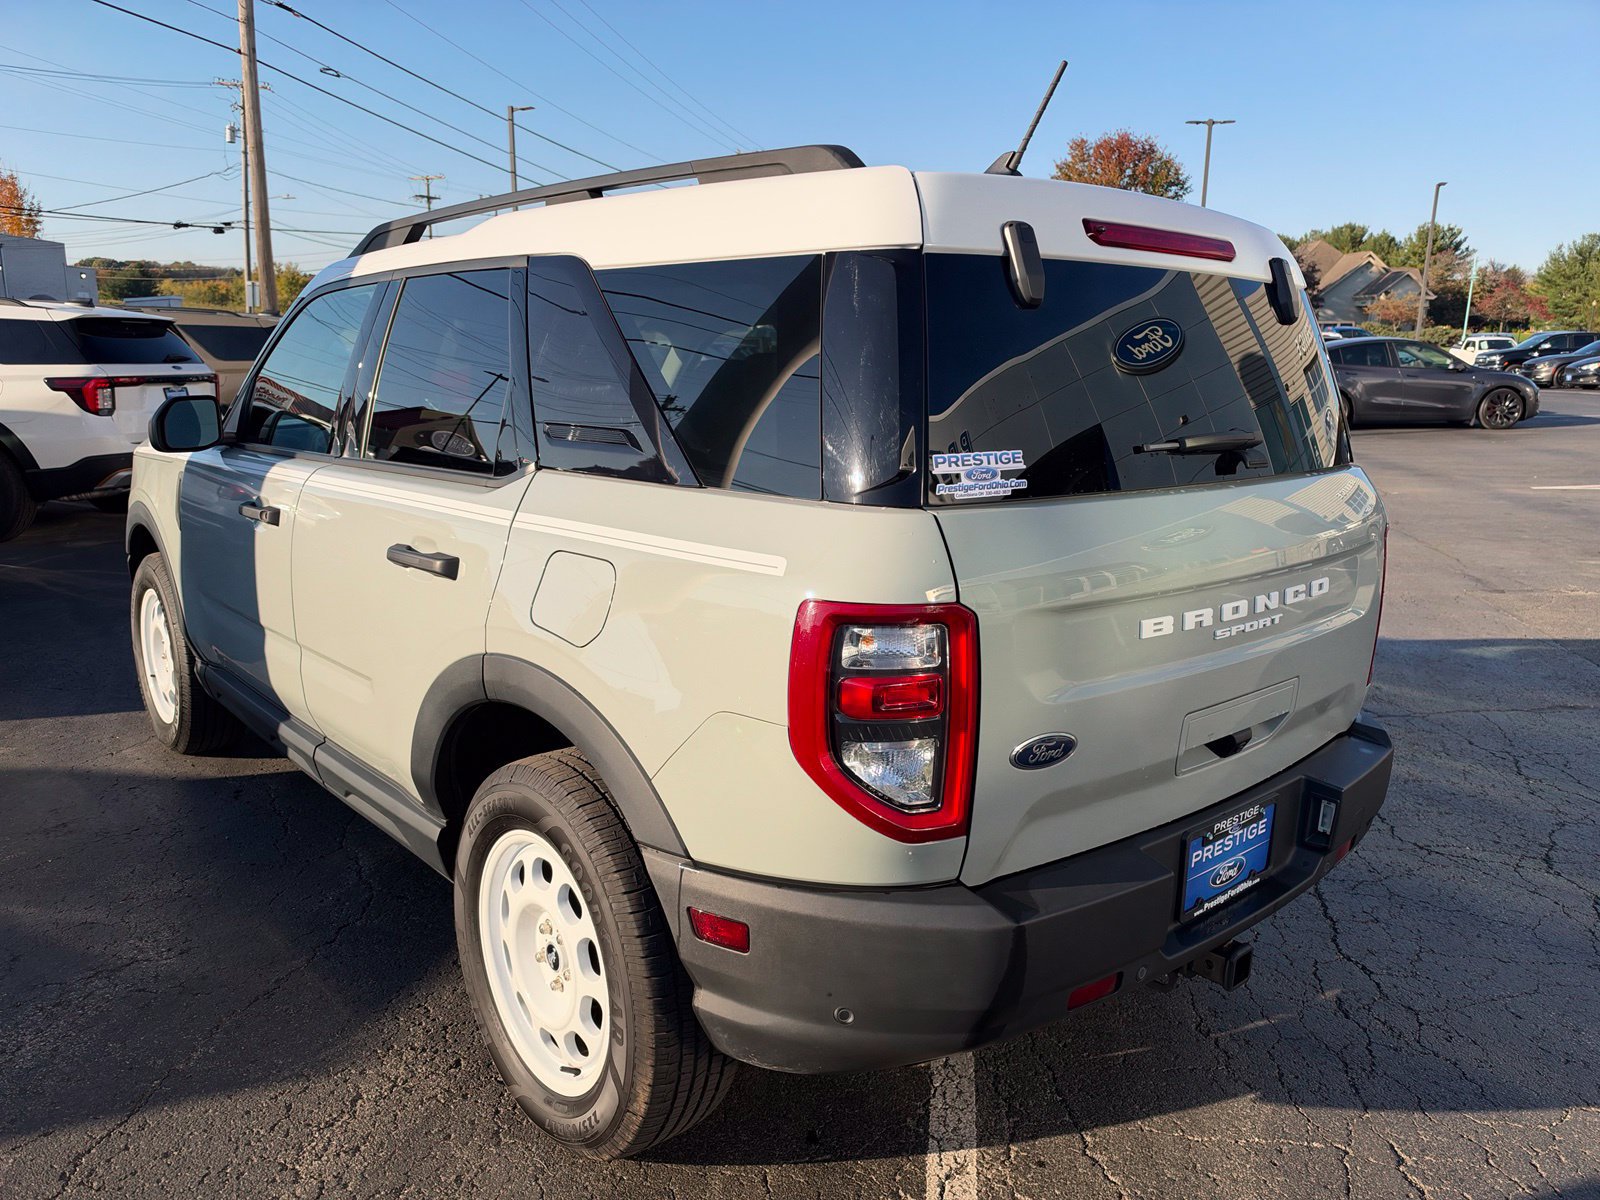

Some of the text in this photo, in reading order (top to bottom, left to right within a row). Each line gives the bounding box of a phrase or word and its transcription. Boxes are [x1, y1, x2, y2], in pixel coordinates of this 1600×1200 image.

[933, 451, 1023, 468] PRESTIGE
[971, 468, 993, 480] Ford
[937, 480, 1027, 494] PrestigeFordOhio.Com
[1139, 576, 1330, 640] BRONCO
[1213, 613, 1284, 640] SPORT
[1028, 740, 1065, 764] Ford
[1213, 805, 1260, 833] PRESTIGE
[1191, 818, 1268, 868] PRESTIGE
[1216, 860, 1240, 885] Ford
